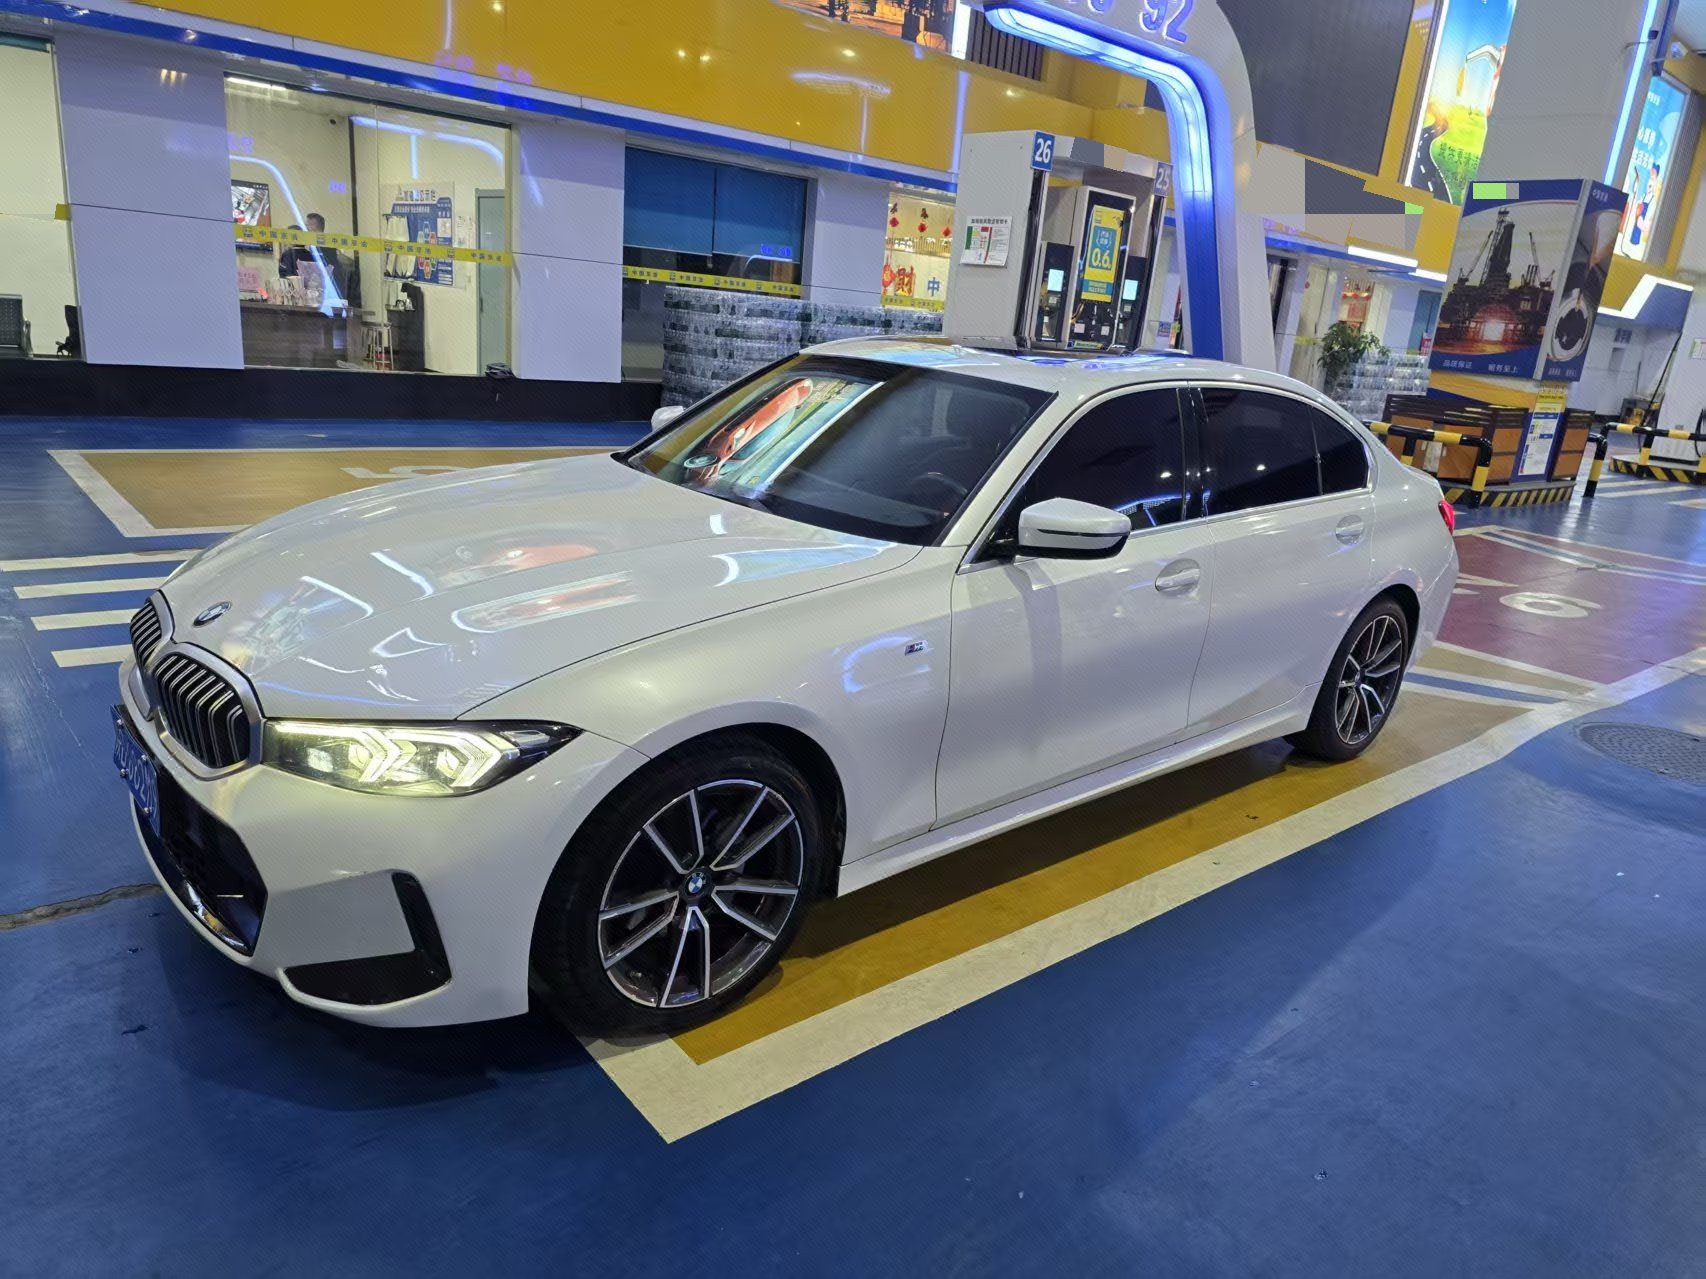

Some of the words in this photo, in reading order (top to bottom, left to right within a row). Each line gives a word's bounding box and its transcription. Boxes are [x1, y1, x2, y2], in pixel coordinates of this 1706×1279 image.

[1139, 0, 1194, 44] 92
[1034, 138, 1052, 164] 26
[1155, 168, 1169, 189] 25
[927, 277, 940, 297] 中
[1442, 359, 1473, 370] 品质保证
[1488, 363, 1519, 374] 服务至上
